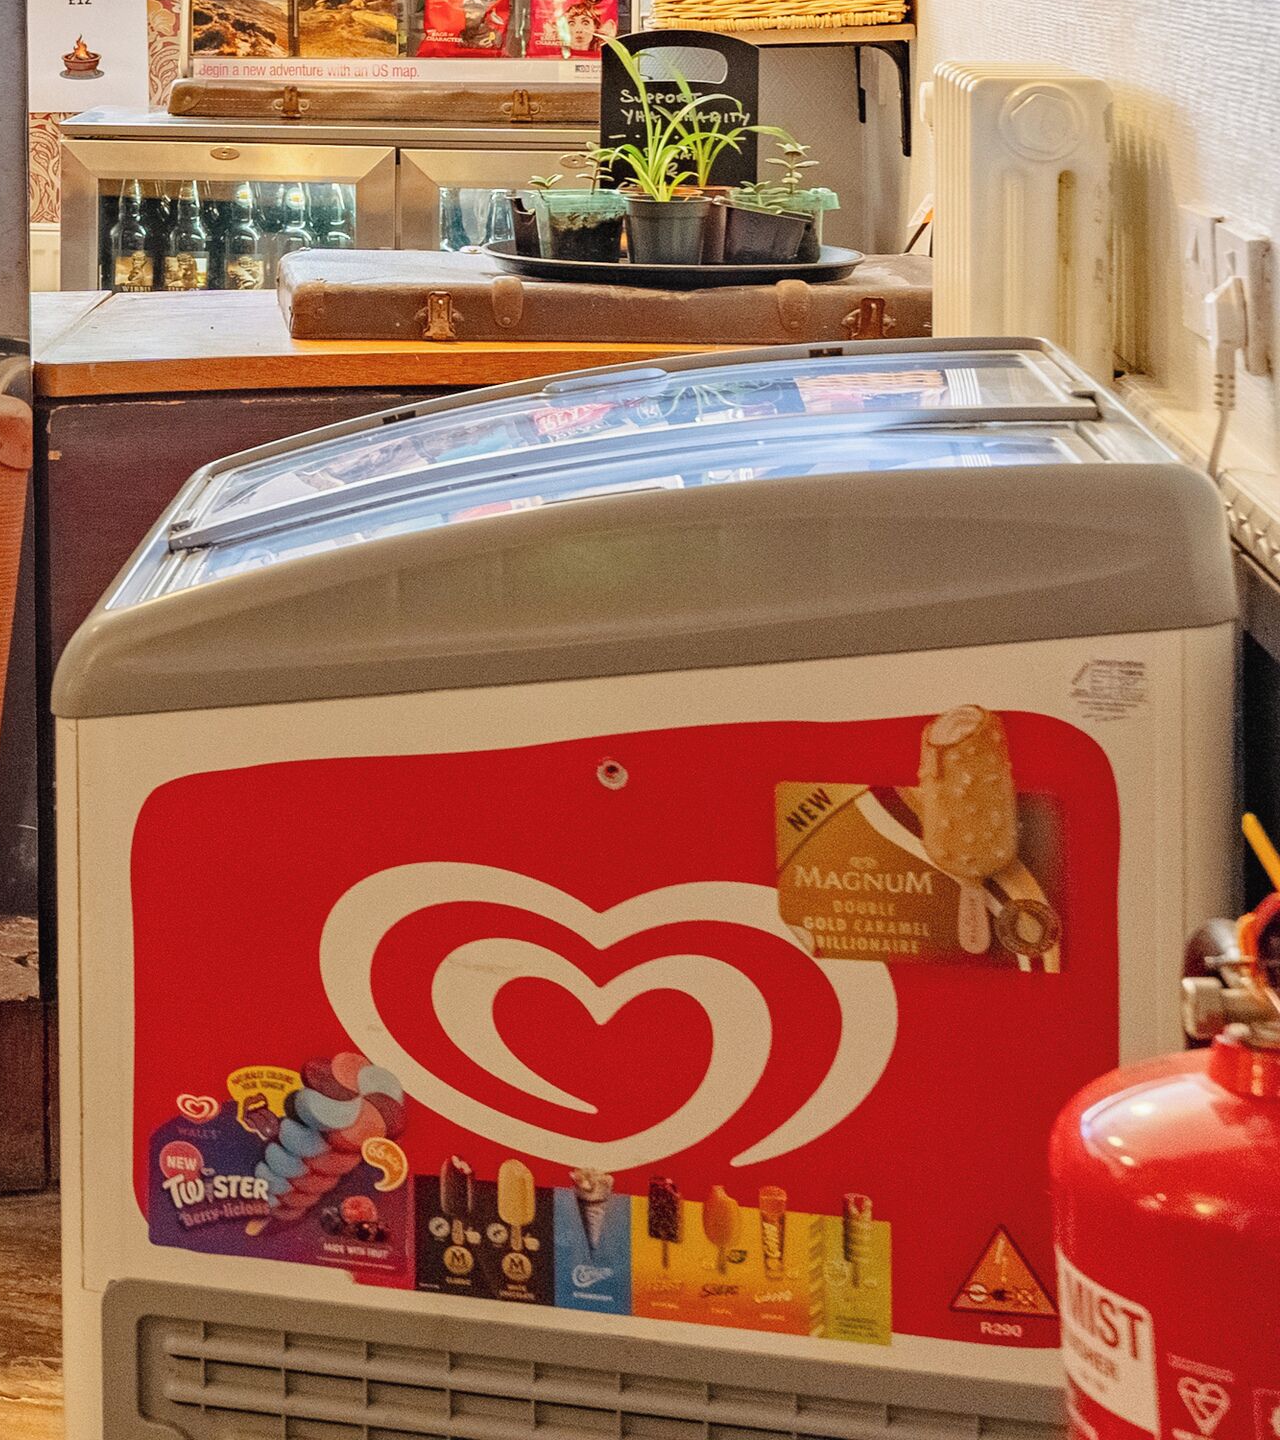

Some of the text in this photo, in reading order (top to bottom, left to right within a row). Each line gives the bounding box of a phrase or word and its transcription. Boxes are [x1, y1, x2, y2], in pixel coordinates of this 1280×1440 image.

[232, 67, 240, 77] a
[242, 66, 267, 77] new
[268, 62, 324, 77] adventure
[327, 62, 351, 77] with
[353, 65, 368, 77] an
[371, 62, 389, 77] OS
[391, 65, 420, 80] map.
[620, 109, 661, 125] YHA
[786, 787, 834, 833] NEW
[793, 865, 933, 895] MAGNUM
[833, 900, 896, 917] DOUBLE
[803, 916, 931, 937] GOLD CARAMEL
[166, 1155, 197, 1171] NEW
[162, 1174, 269, 1209] TWISTER
[979, 1321, 1023, 1338] R290
